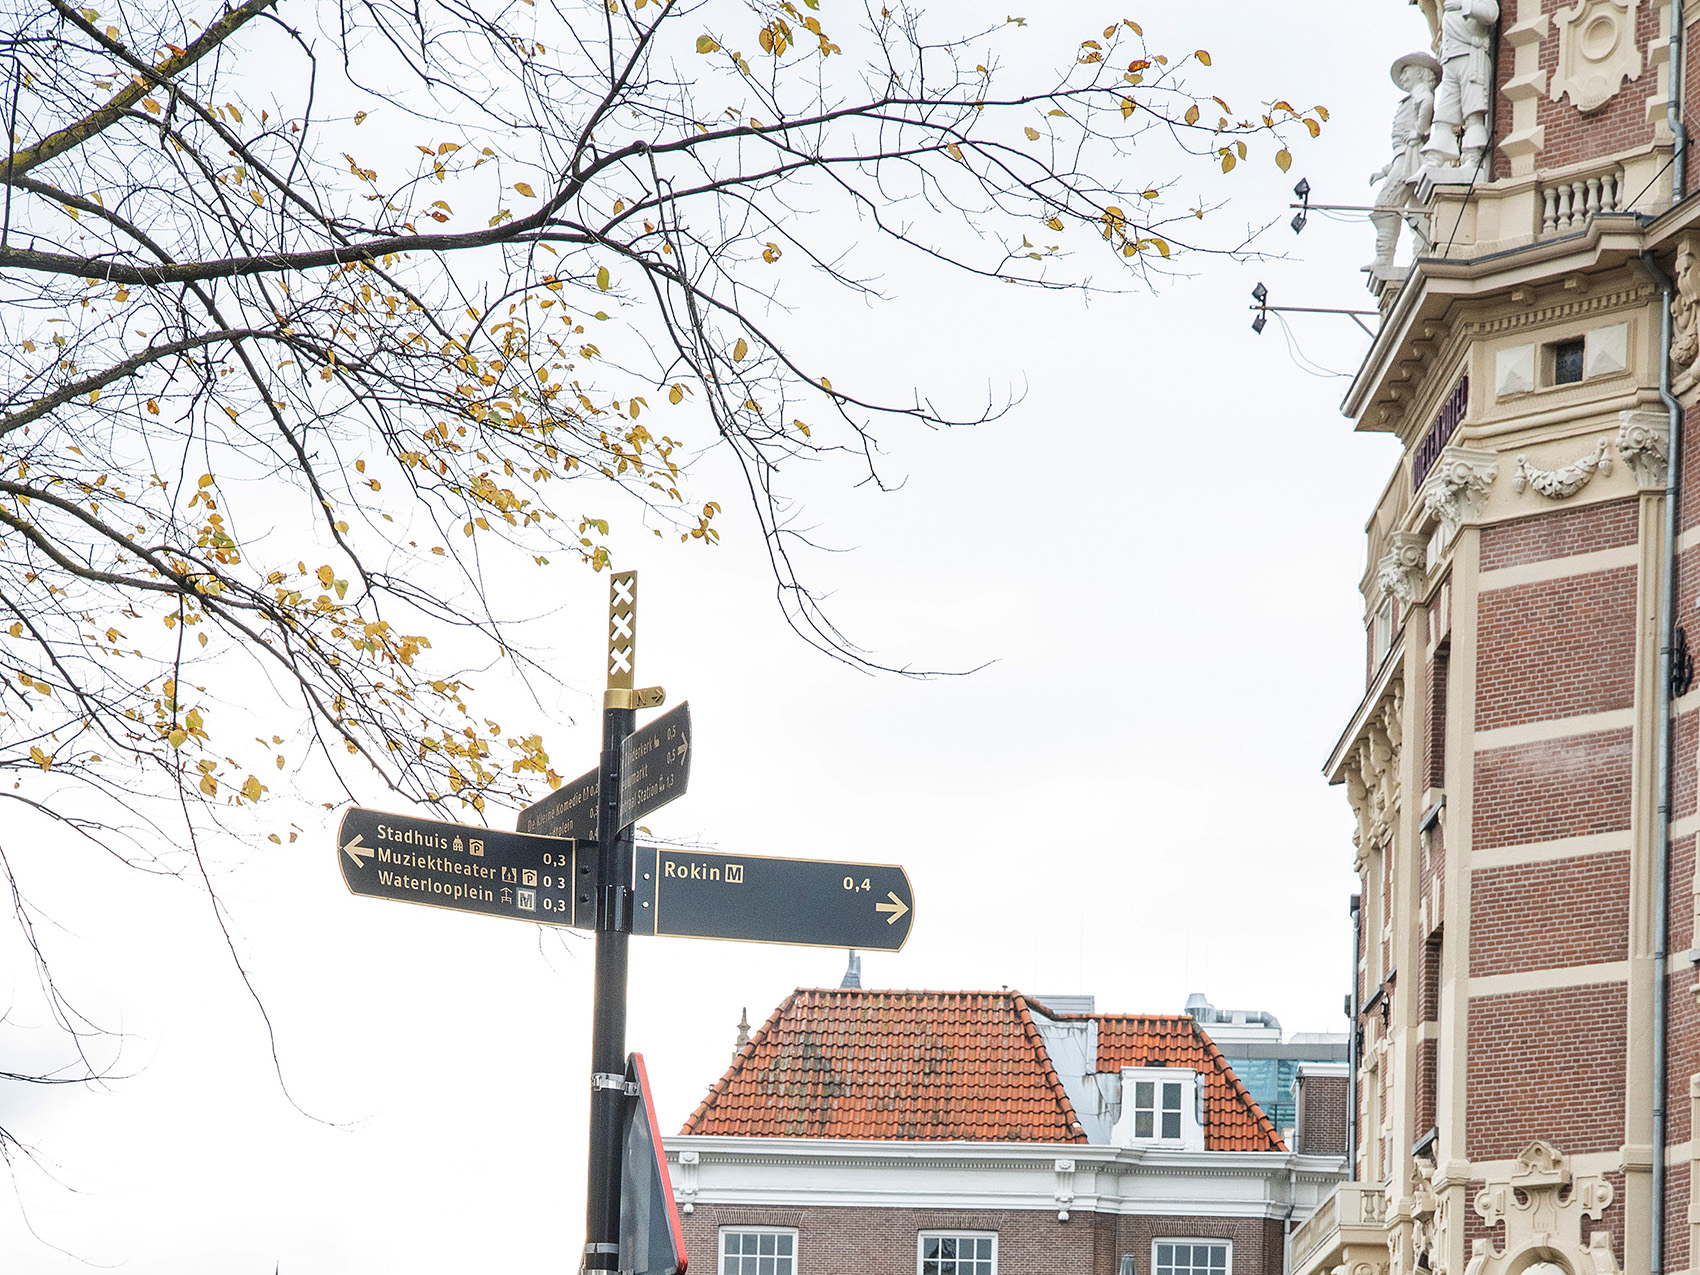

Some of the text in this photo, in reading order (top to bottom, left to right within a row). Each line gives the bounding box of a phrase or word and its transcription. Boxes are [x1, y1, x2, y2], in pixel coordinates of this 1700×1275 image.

[667, 749, 676, 764] 0,5
[637, 782, 659, 805] Station
[527, 819, 535, 833] De
[537, 809, 555, 828] Kleine
[556, 792, 582, 817] Komedie
[377, 824, 448, 850] Stadhuis
[378, 848, 497, 880] Muziektheater
[543, 853, 566, 867] 0,3
[378, 870, 494, 902] Waterlooplein
[543, 898, 566, 913] 0,3
[664, 861, 720, 881] Rokin
[843, 877, 871, 893] 0,4
